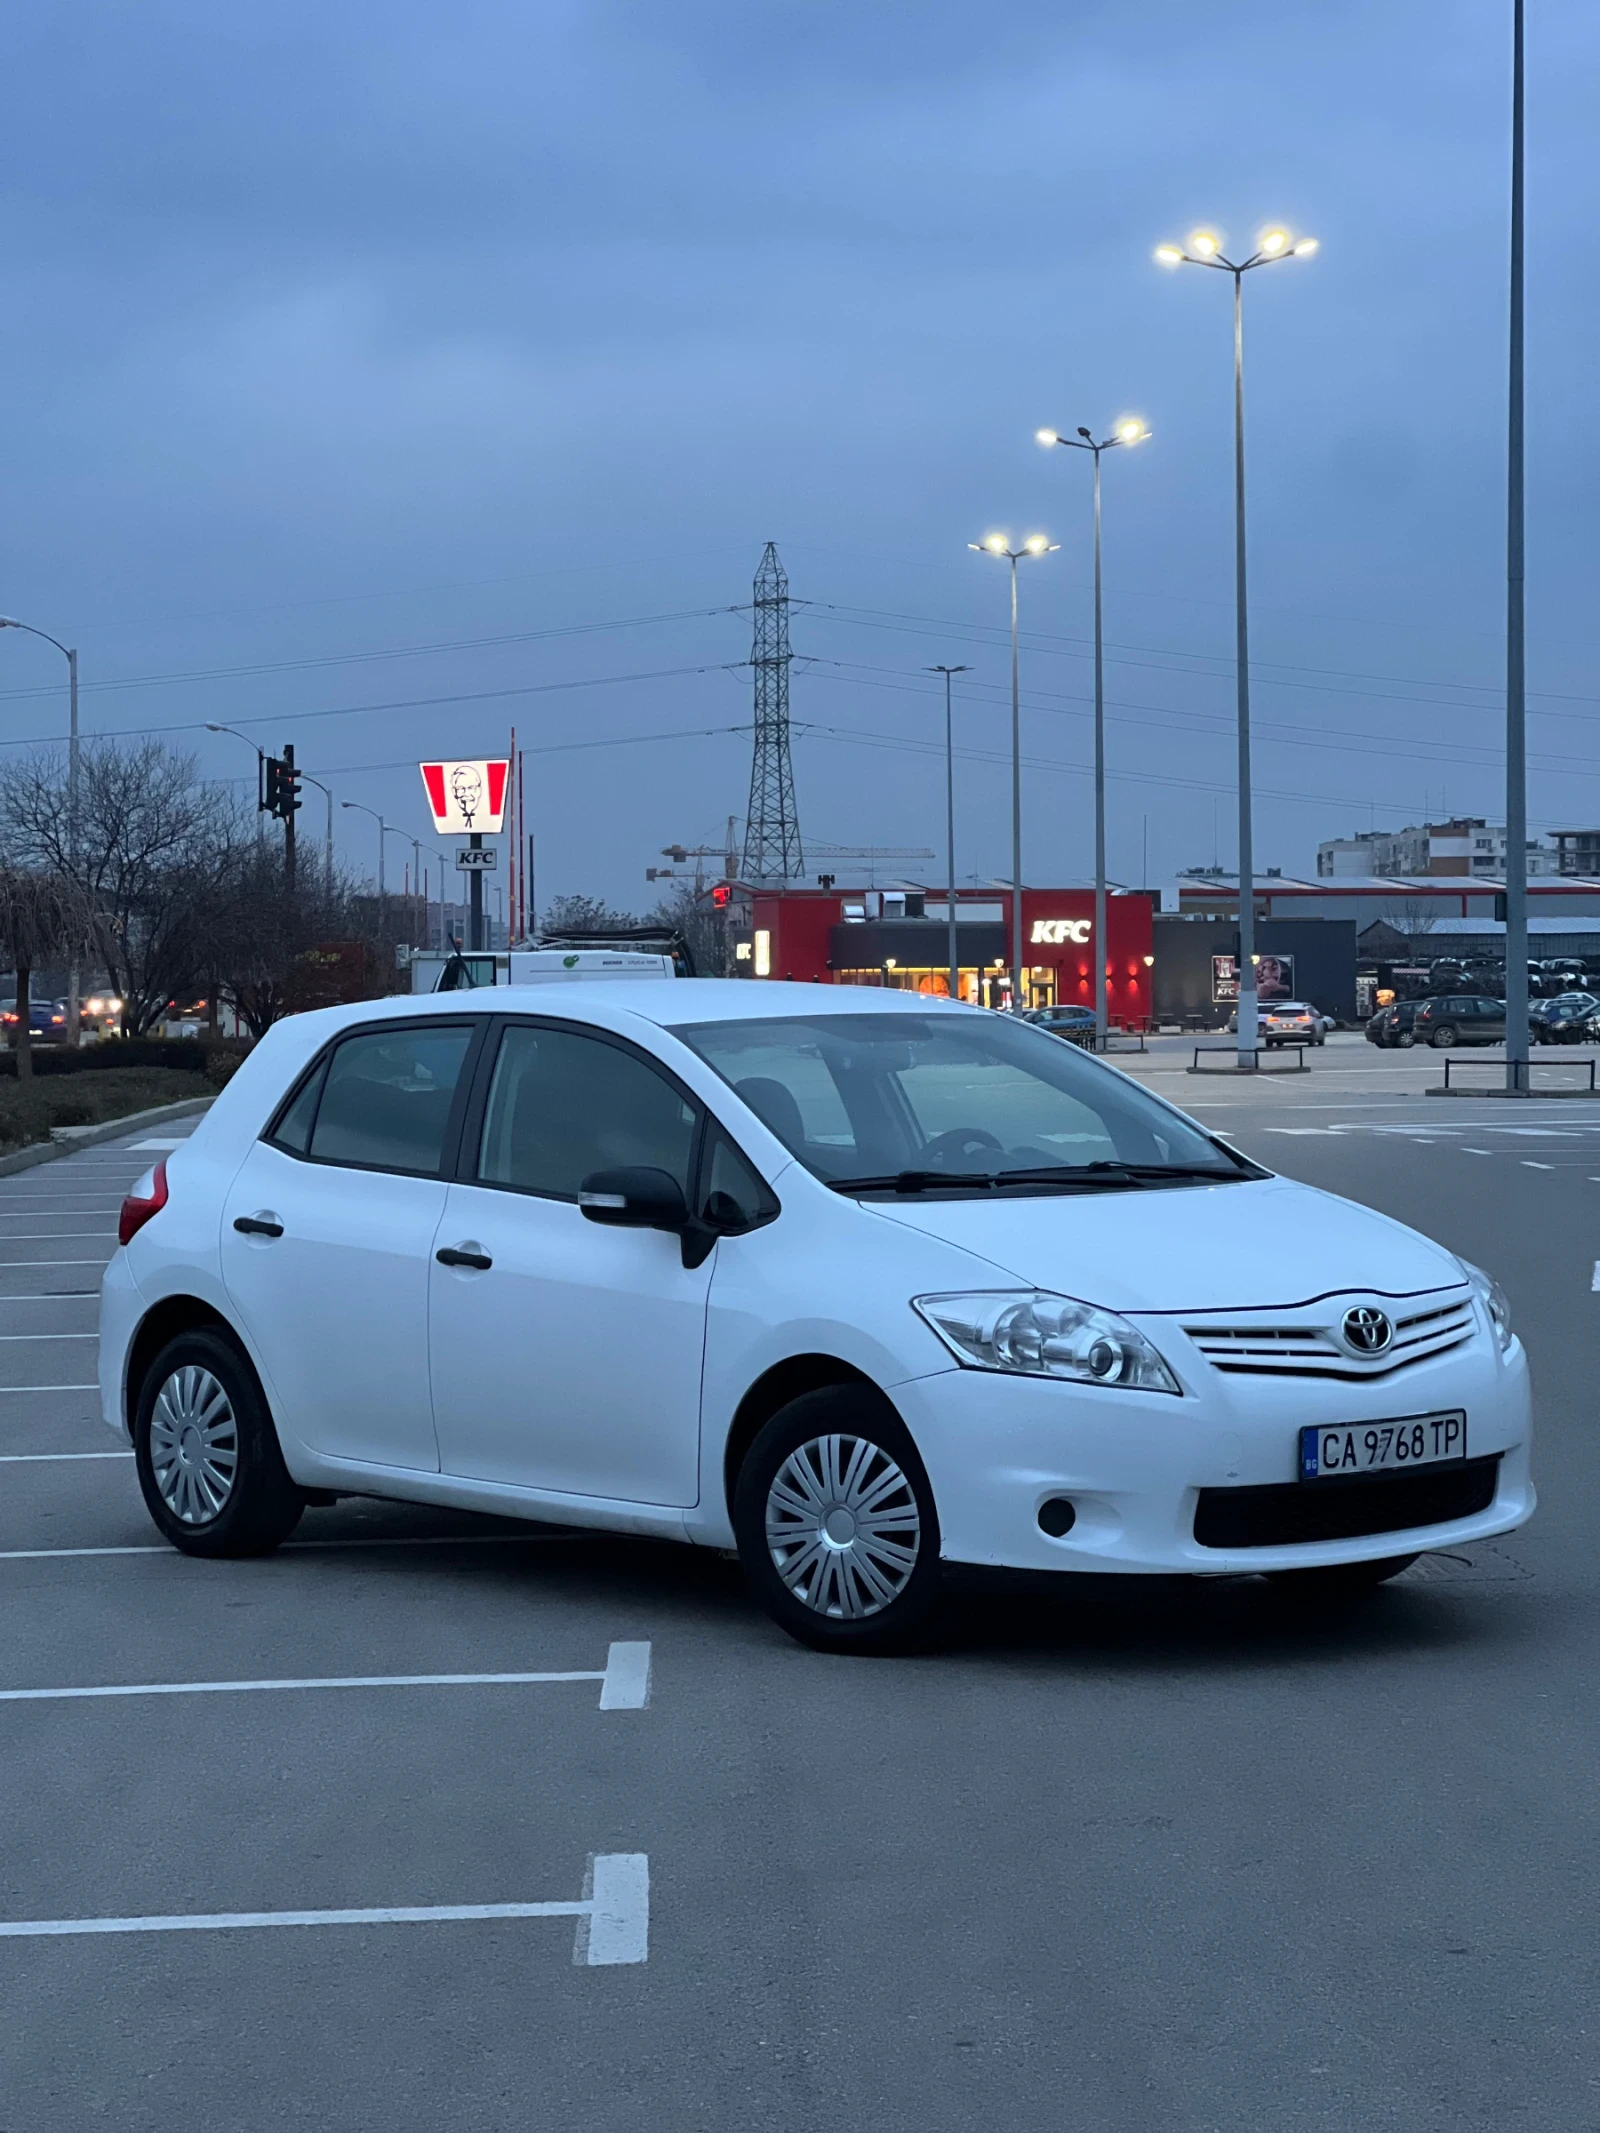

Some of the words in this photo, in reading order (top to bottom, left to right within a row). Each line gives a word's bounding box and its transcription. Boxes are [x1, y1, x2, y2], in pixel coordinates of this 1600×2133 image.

[459, 852, 493, 864] KFC
[1030, 920, 1092, 943] KFC
[1323, 1433, 1357, 1468] CA
[1364, 1424, 1425, 1465] 9768
[1430, 1418, 1459, 1456] TP
[1305, 1459, 1317, 1470] BG
